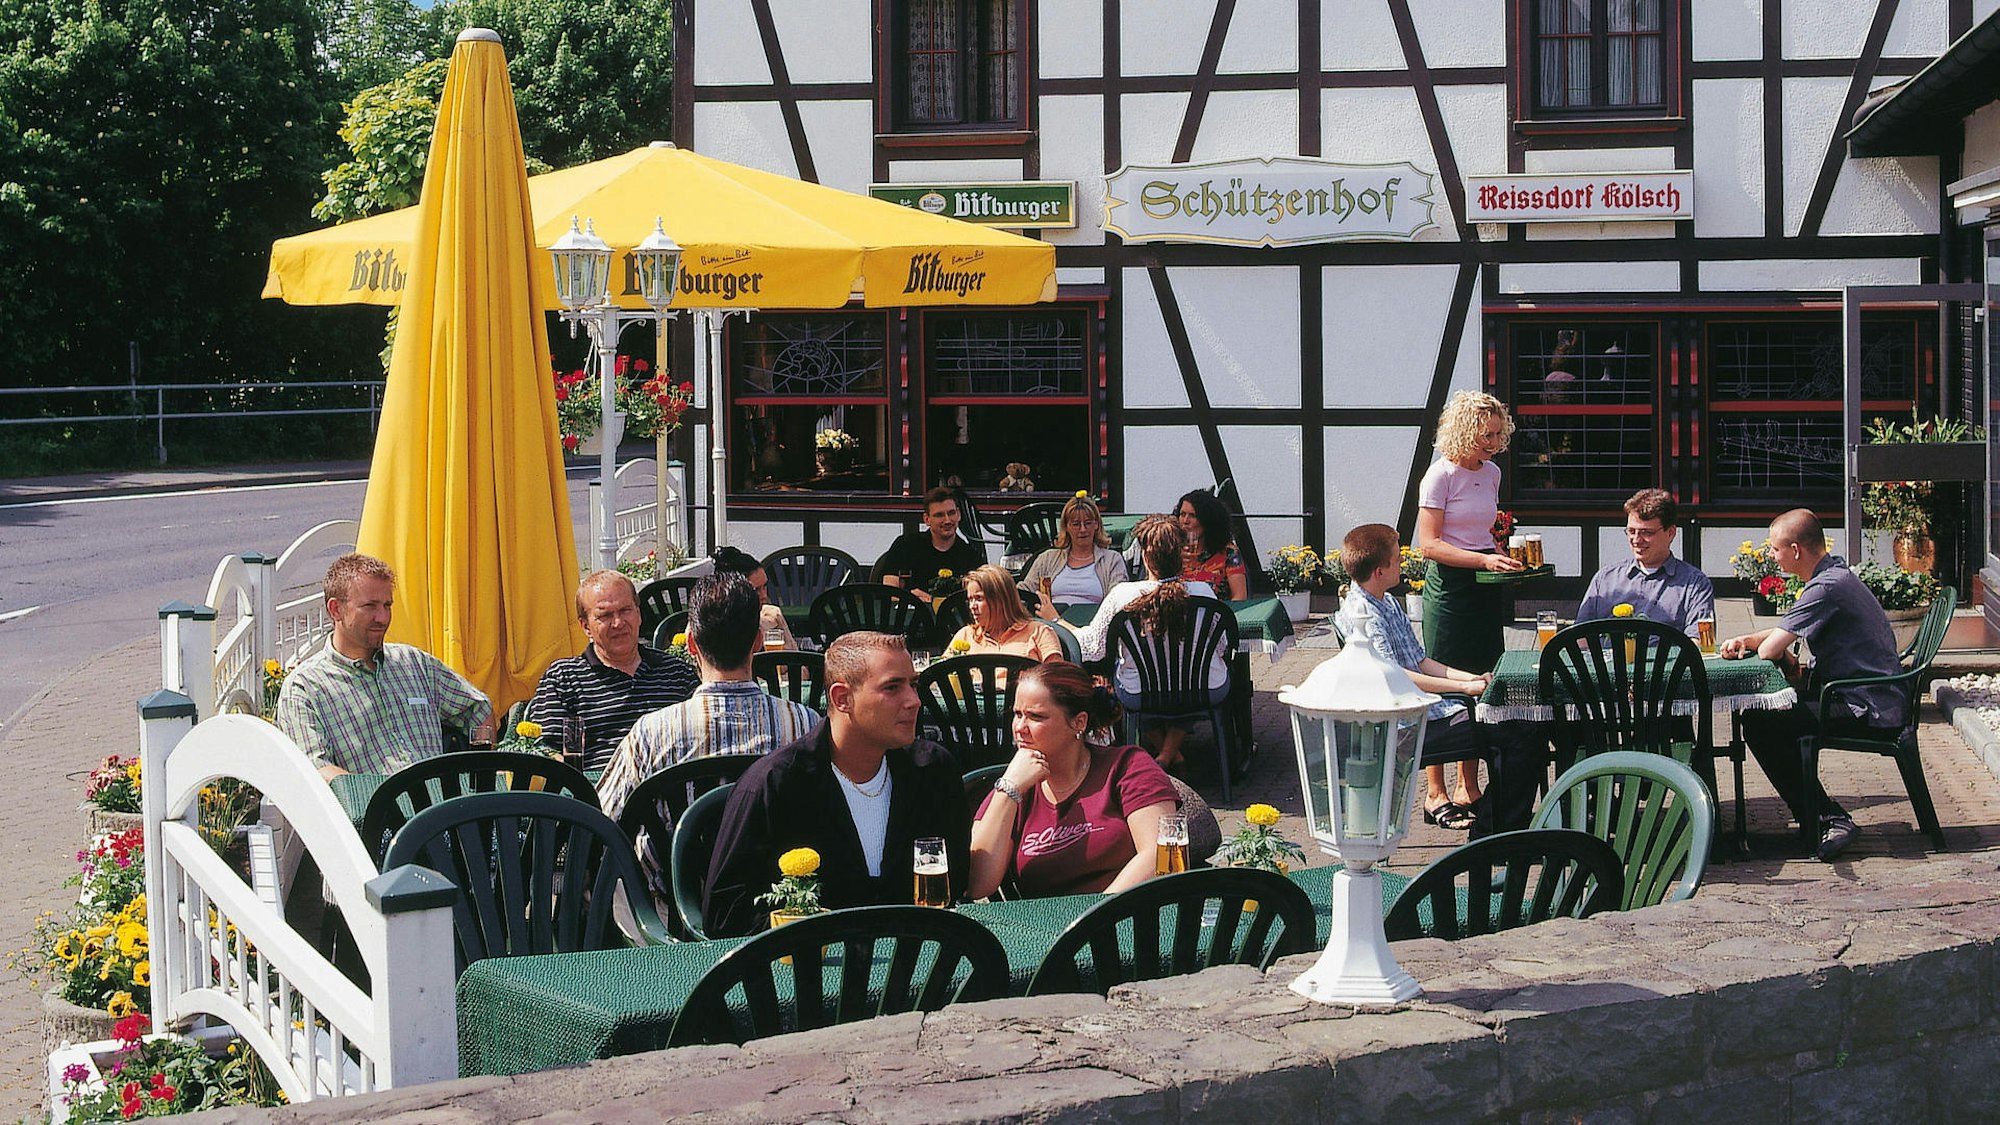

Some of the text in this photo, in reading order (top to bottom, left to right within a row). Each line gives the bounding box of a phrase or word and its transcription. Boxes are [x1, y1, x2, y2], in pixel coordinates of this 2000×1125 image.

[953, 191, 1061, 221] Bitburger
[1140, 177, 1402, 226] Schützenhof
[1477, 181, 1681, 213] Reissdorf Kölsch
[348, 248, 407, 292] Bitb
[902, 250, 986, 298] Bitburger
